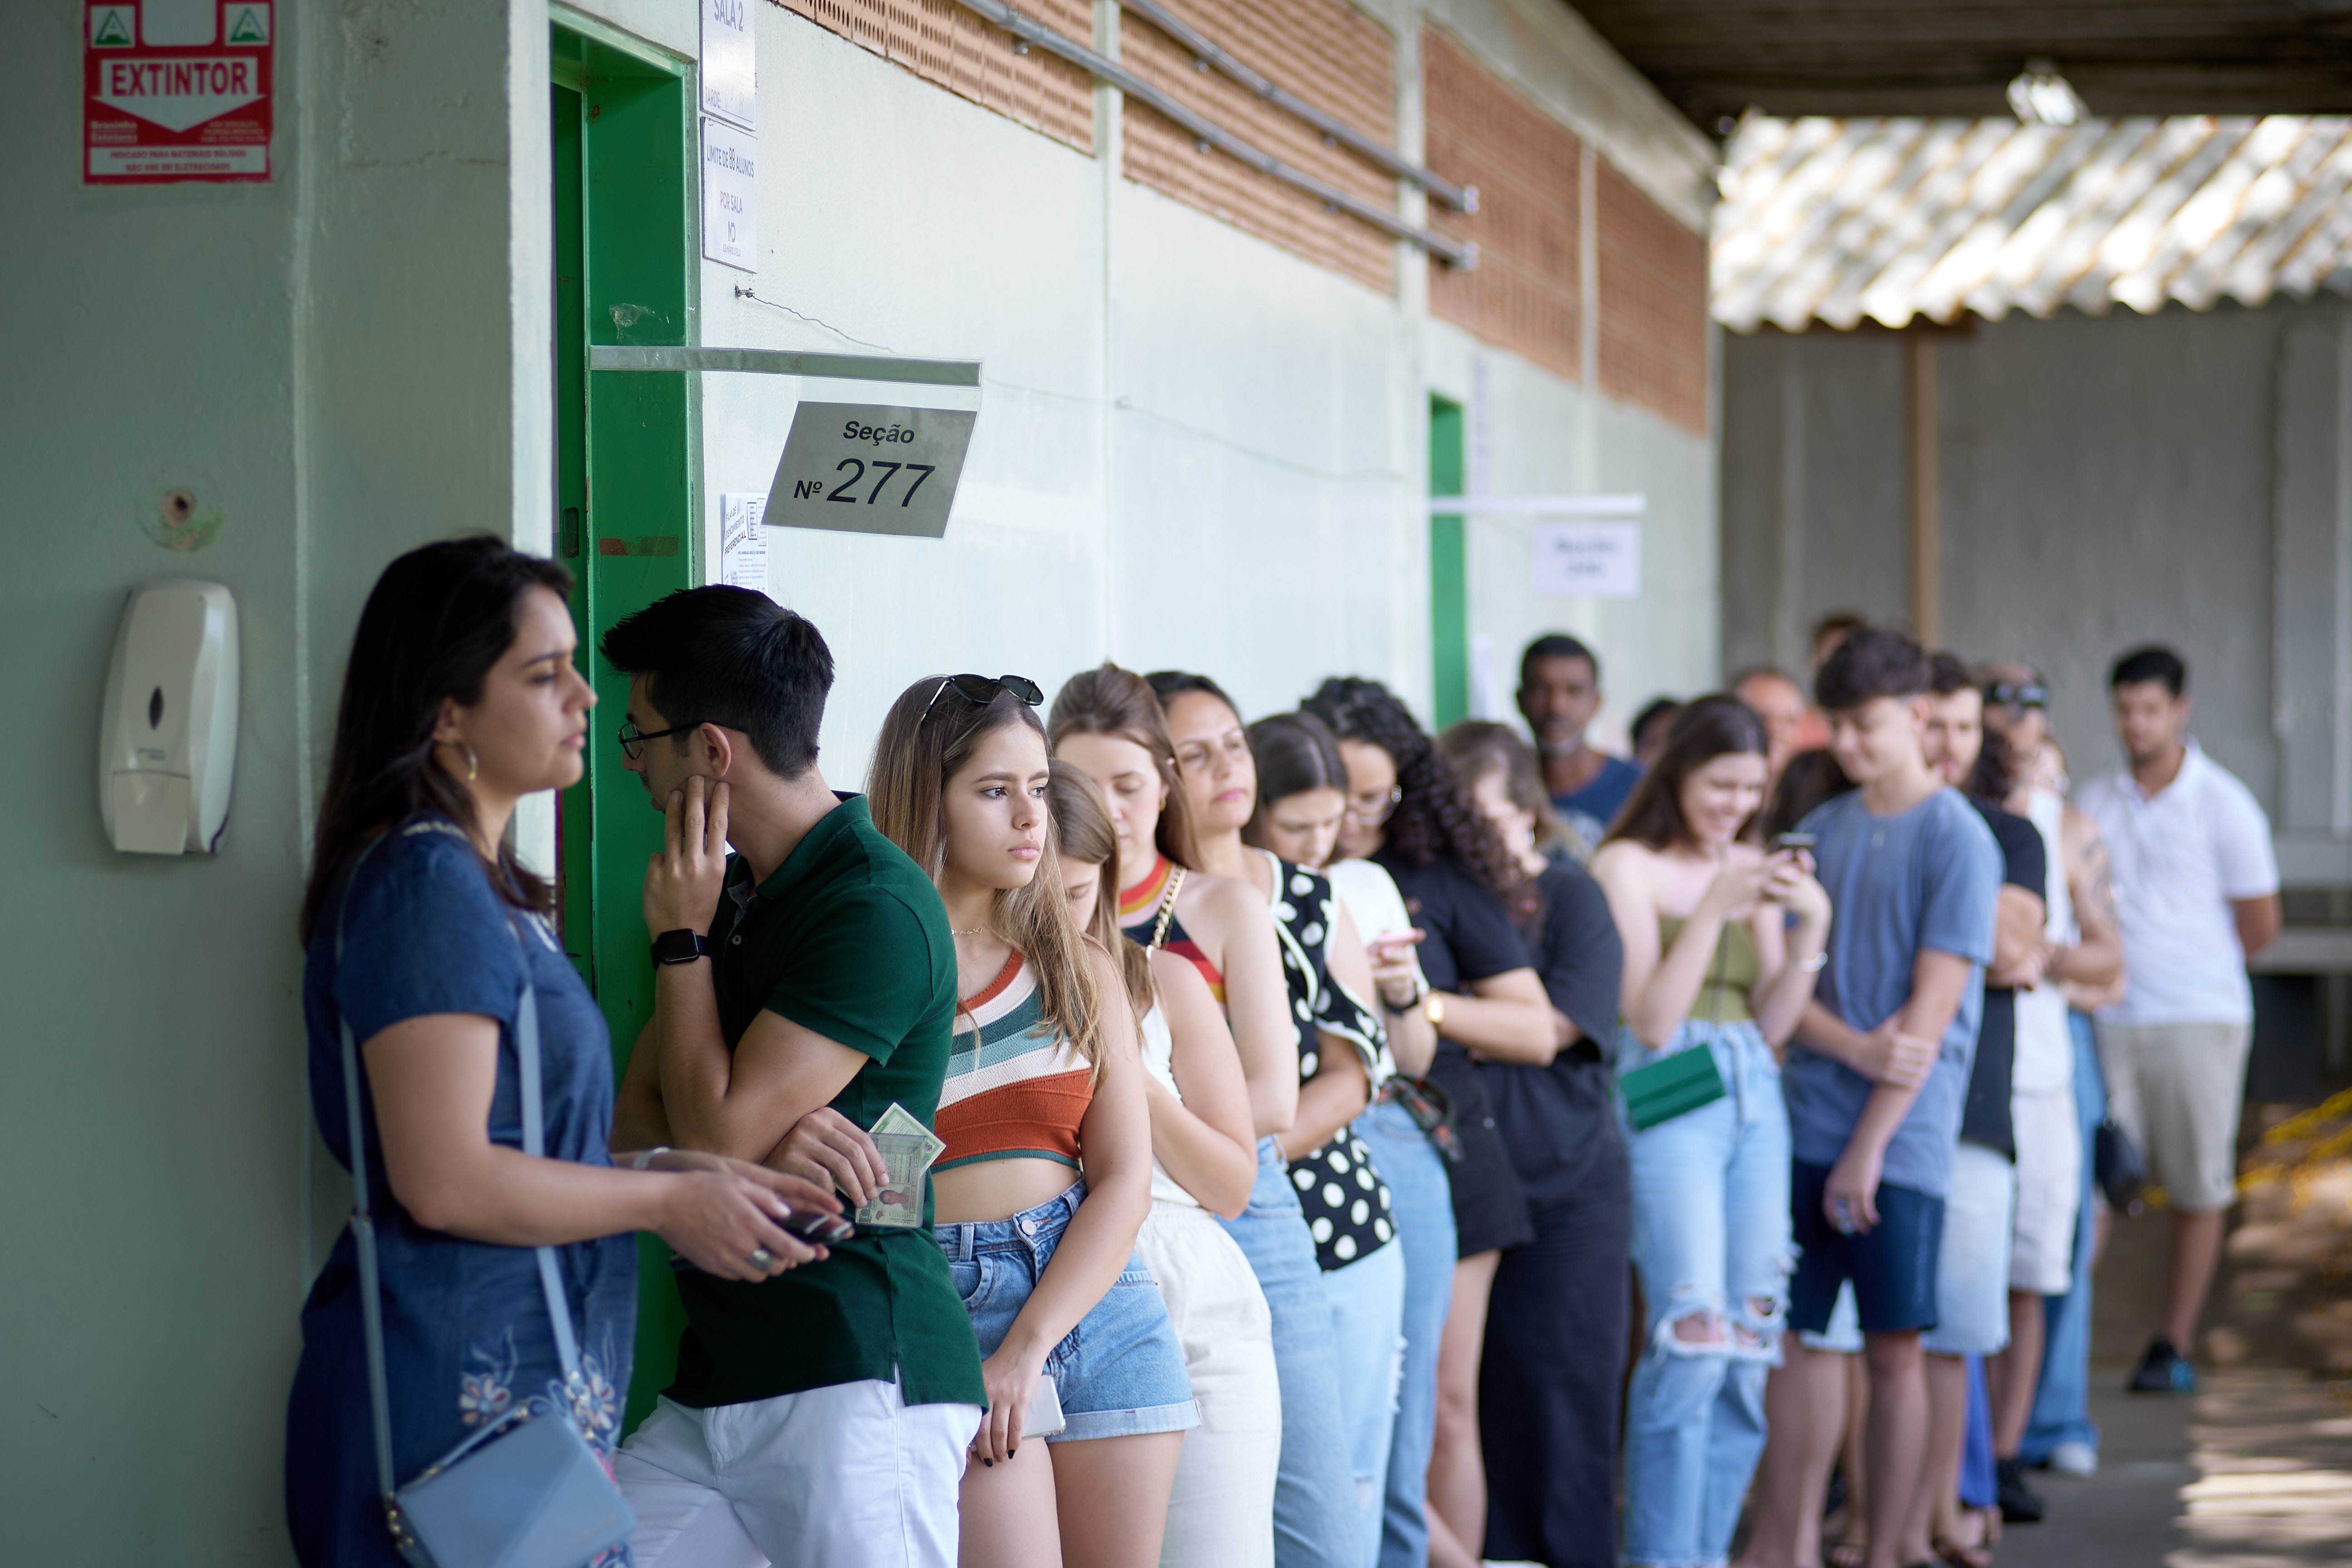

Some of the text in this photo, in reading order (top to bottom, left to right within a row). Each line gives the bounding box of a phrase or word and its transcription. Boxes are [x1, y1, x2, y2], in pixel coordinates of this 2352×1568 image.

[714, 0, 743, 32] SALA 2
[112, 62, 248, 97] EXTINTOR
[705, 85, 721, 109] TARDE:
[707, 143, 721, 166] LIMITE
[722, 149, 728, 168] DE
[736, 156, 754, 178] ALUNOS
[720, 191, 743, 215] POR SALA
[843, 420, 915, 446] Seção
[794, 458, 936, 508] Nº 277
[732, 506, 736, 517] DE
[725, 530, 747, 557] PREFERENCIAL
